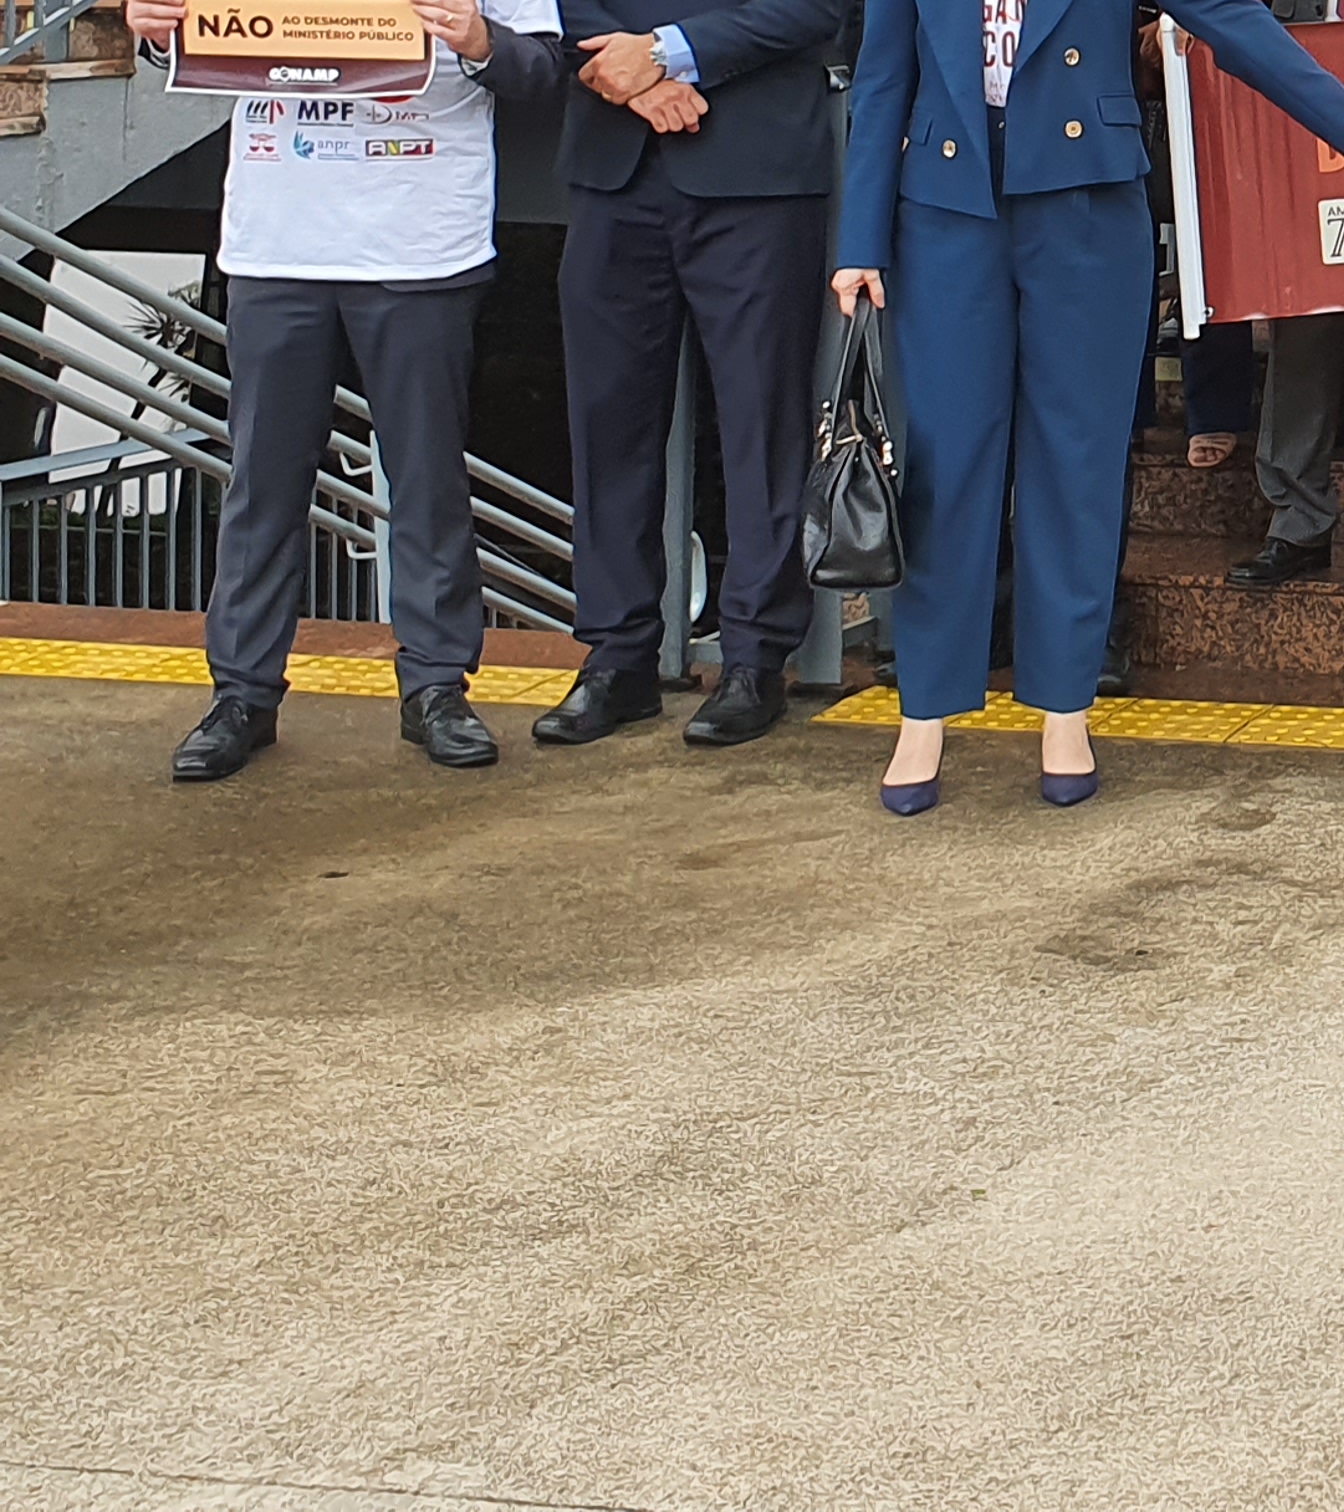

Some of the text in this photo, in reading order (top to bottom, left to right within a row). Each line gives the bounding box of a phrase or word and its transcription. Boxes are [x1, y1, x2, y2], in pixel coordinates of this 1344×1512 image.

[198, 8, 273, 38] NÃO
[282, 16, 396, 27] AO DESMONTE DO
[283, 29, 414, 41] MINISTÉRIO PÚBLICO
[298, 101, 353, 121] MPF
[318, 140, 349, 152] anpr
